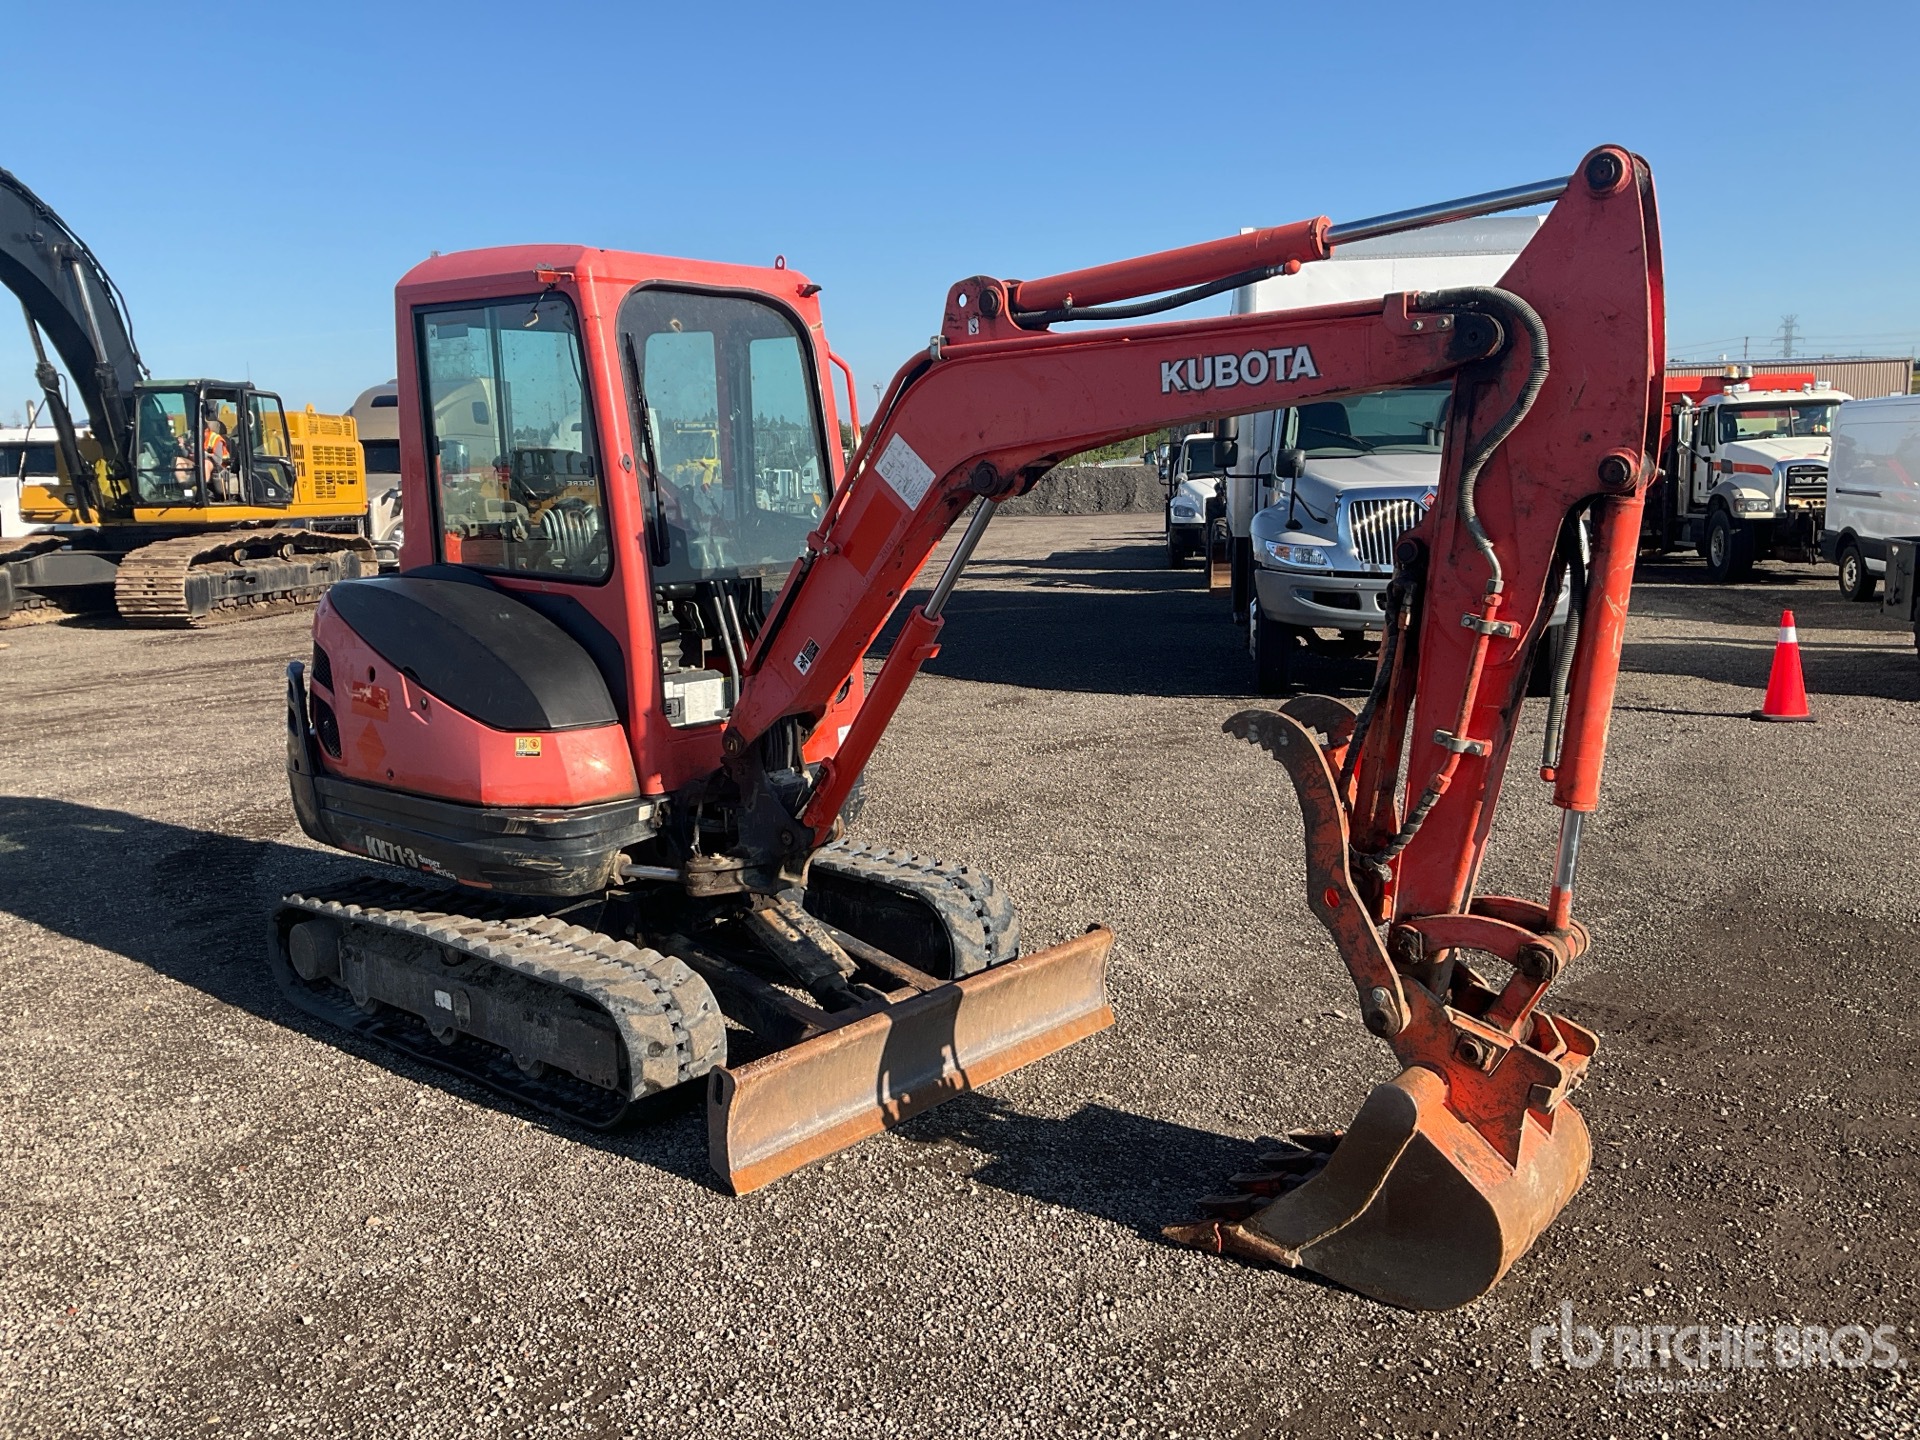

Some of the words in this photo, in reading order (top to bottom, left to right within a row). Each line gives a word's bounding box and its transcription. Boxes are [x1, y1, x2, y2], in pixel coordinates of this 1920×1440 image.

[1160, 345, 1319, 393] KUBOTA
[1795, 476, 1828, 484] MA
[365, 834, 419, 868] KX71-3
[418, 854, 441, 868] Super
[432, 866, 457, 880] Series
